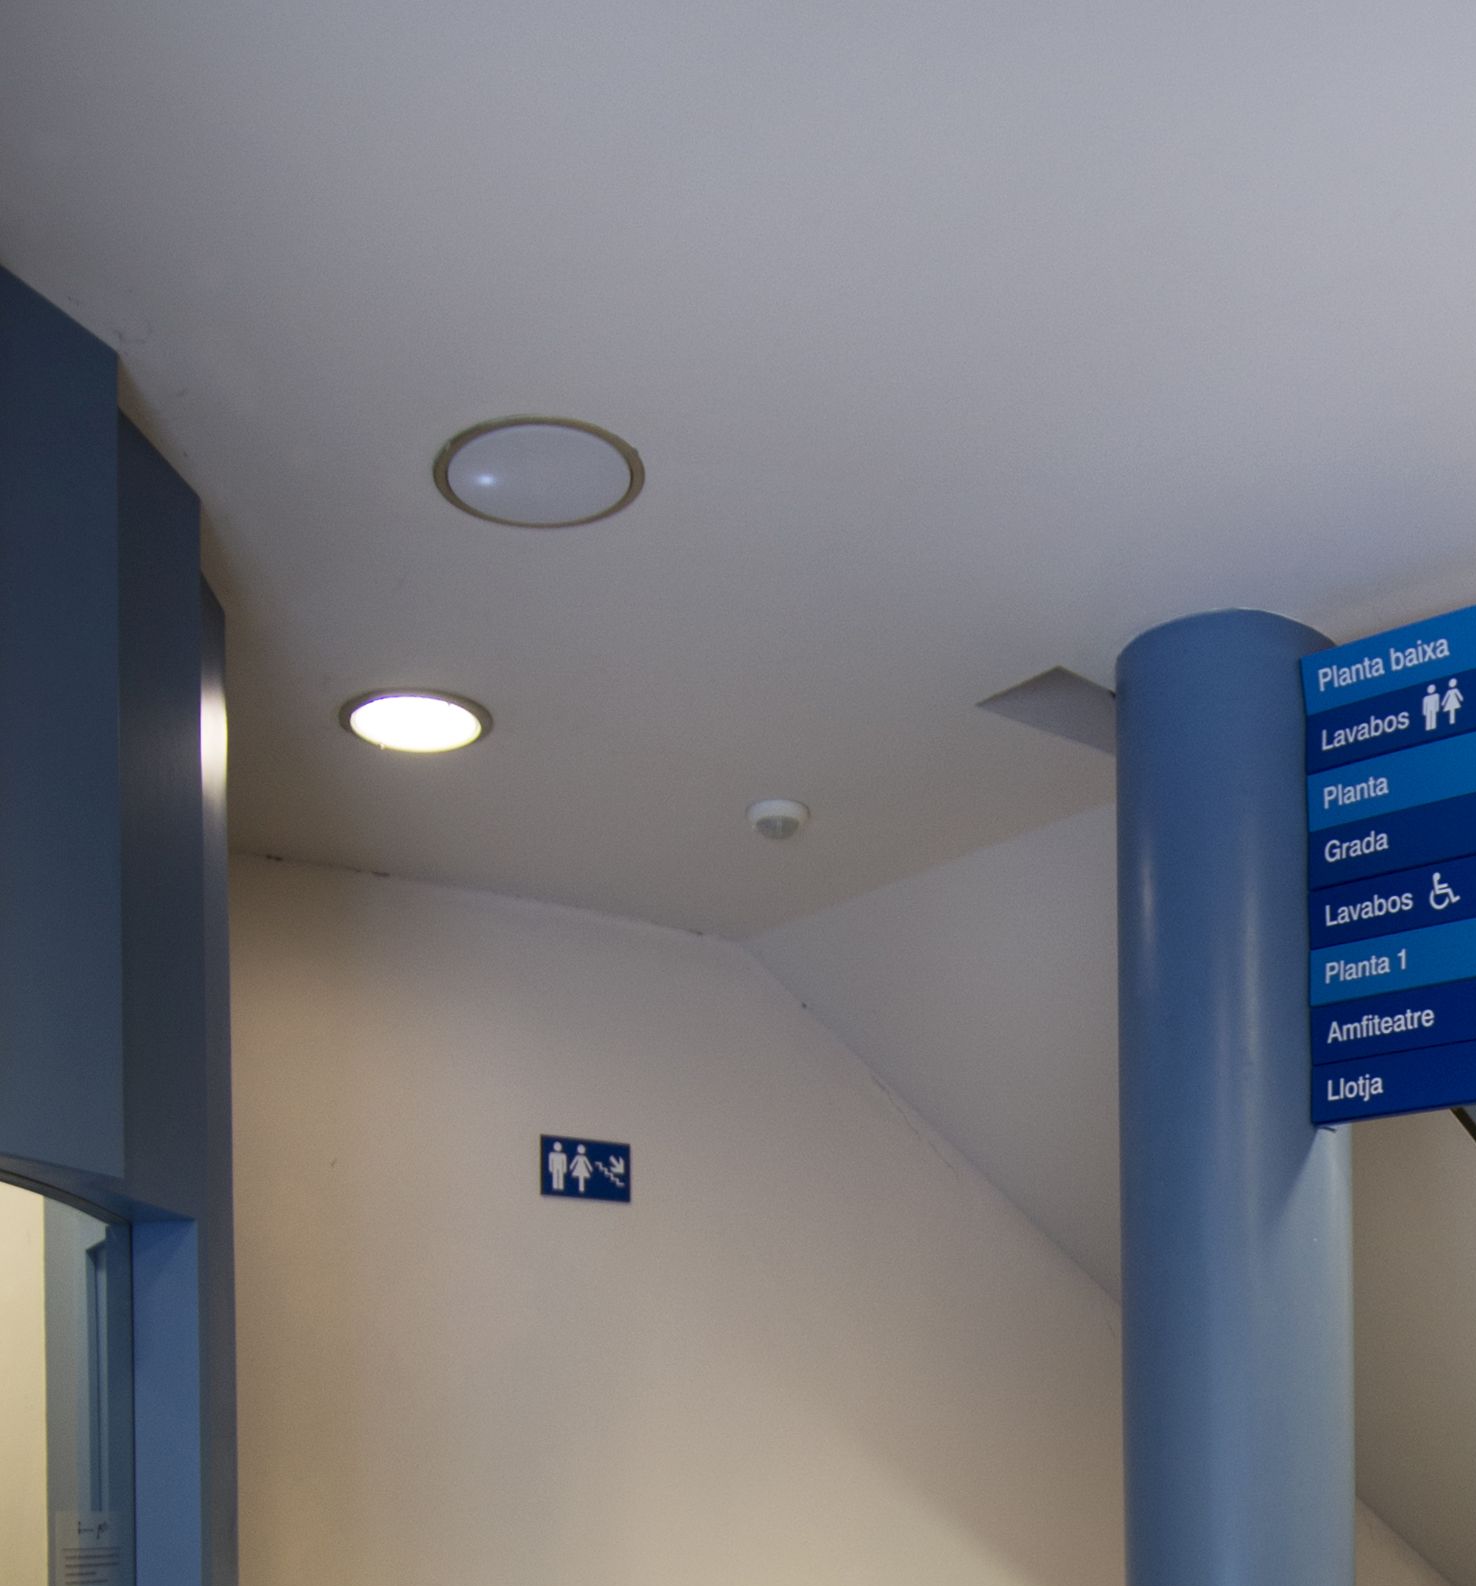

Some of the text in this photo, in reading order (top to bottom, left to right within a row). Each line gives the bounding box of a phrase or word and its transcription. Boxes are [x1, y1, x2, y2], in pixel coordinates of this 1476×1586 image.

[1317, 638, 1451, 693] Planta baixa
[1320, 710, 1411, 751] Lavabos
[1322, 776, 1390, 810] Planta
[1324, 830, 1390, 863] Grada
[1324, 892, 1414, 927] Lavabos
[1324, 948, 1408, 985] Planta 1
[1327, 1008, 1436, 1044] Amfiteatre
[1327, 1073, 1384, 1102] Llotja
